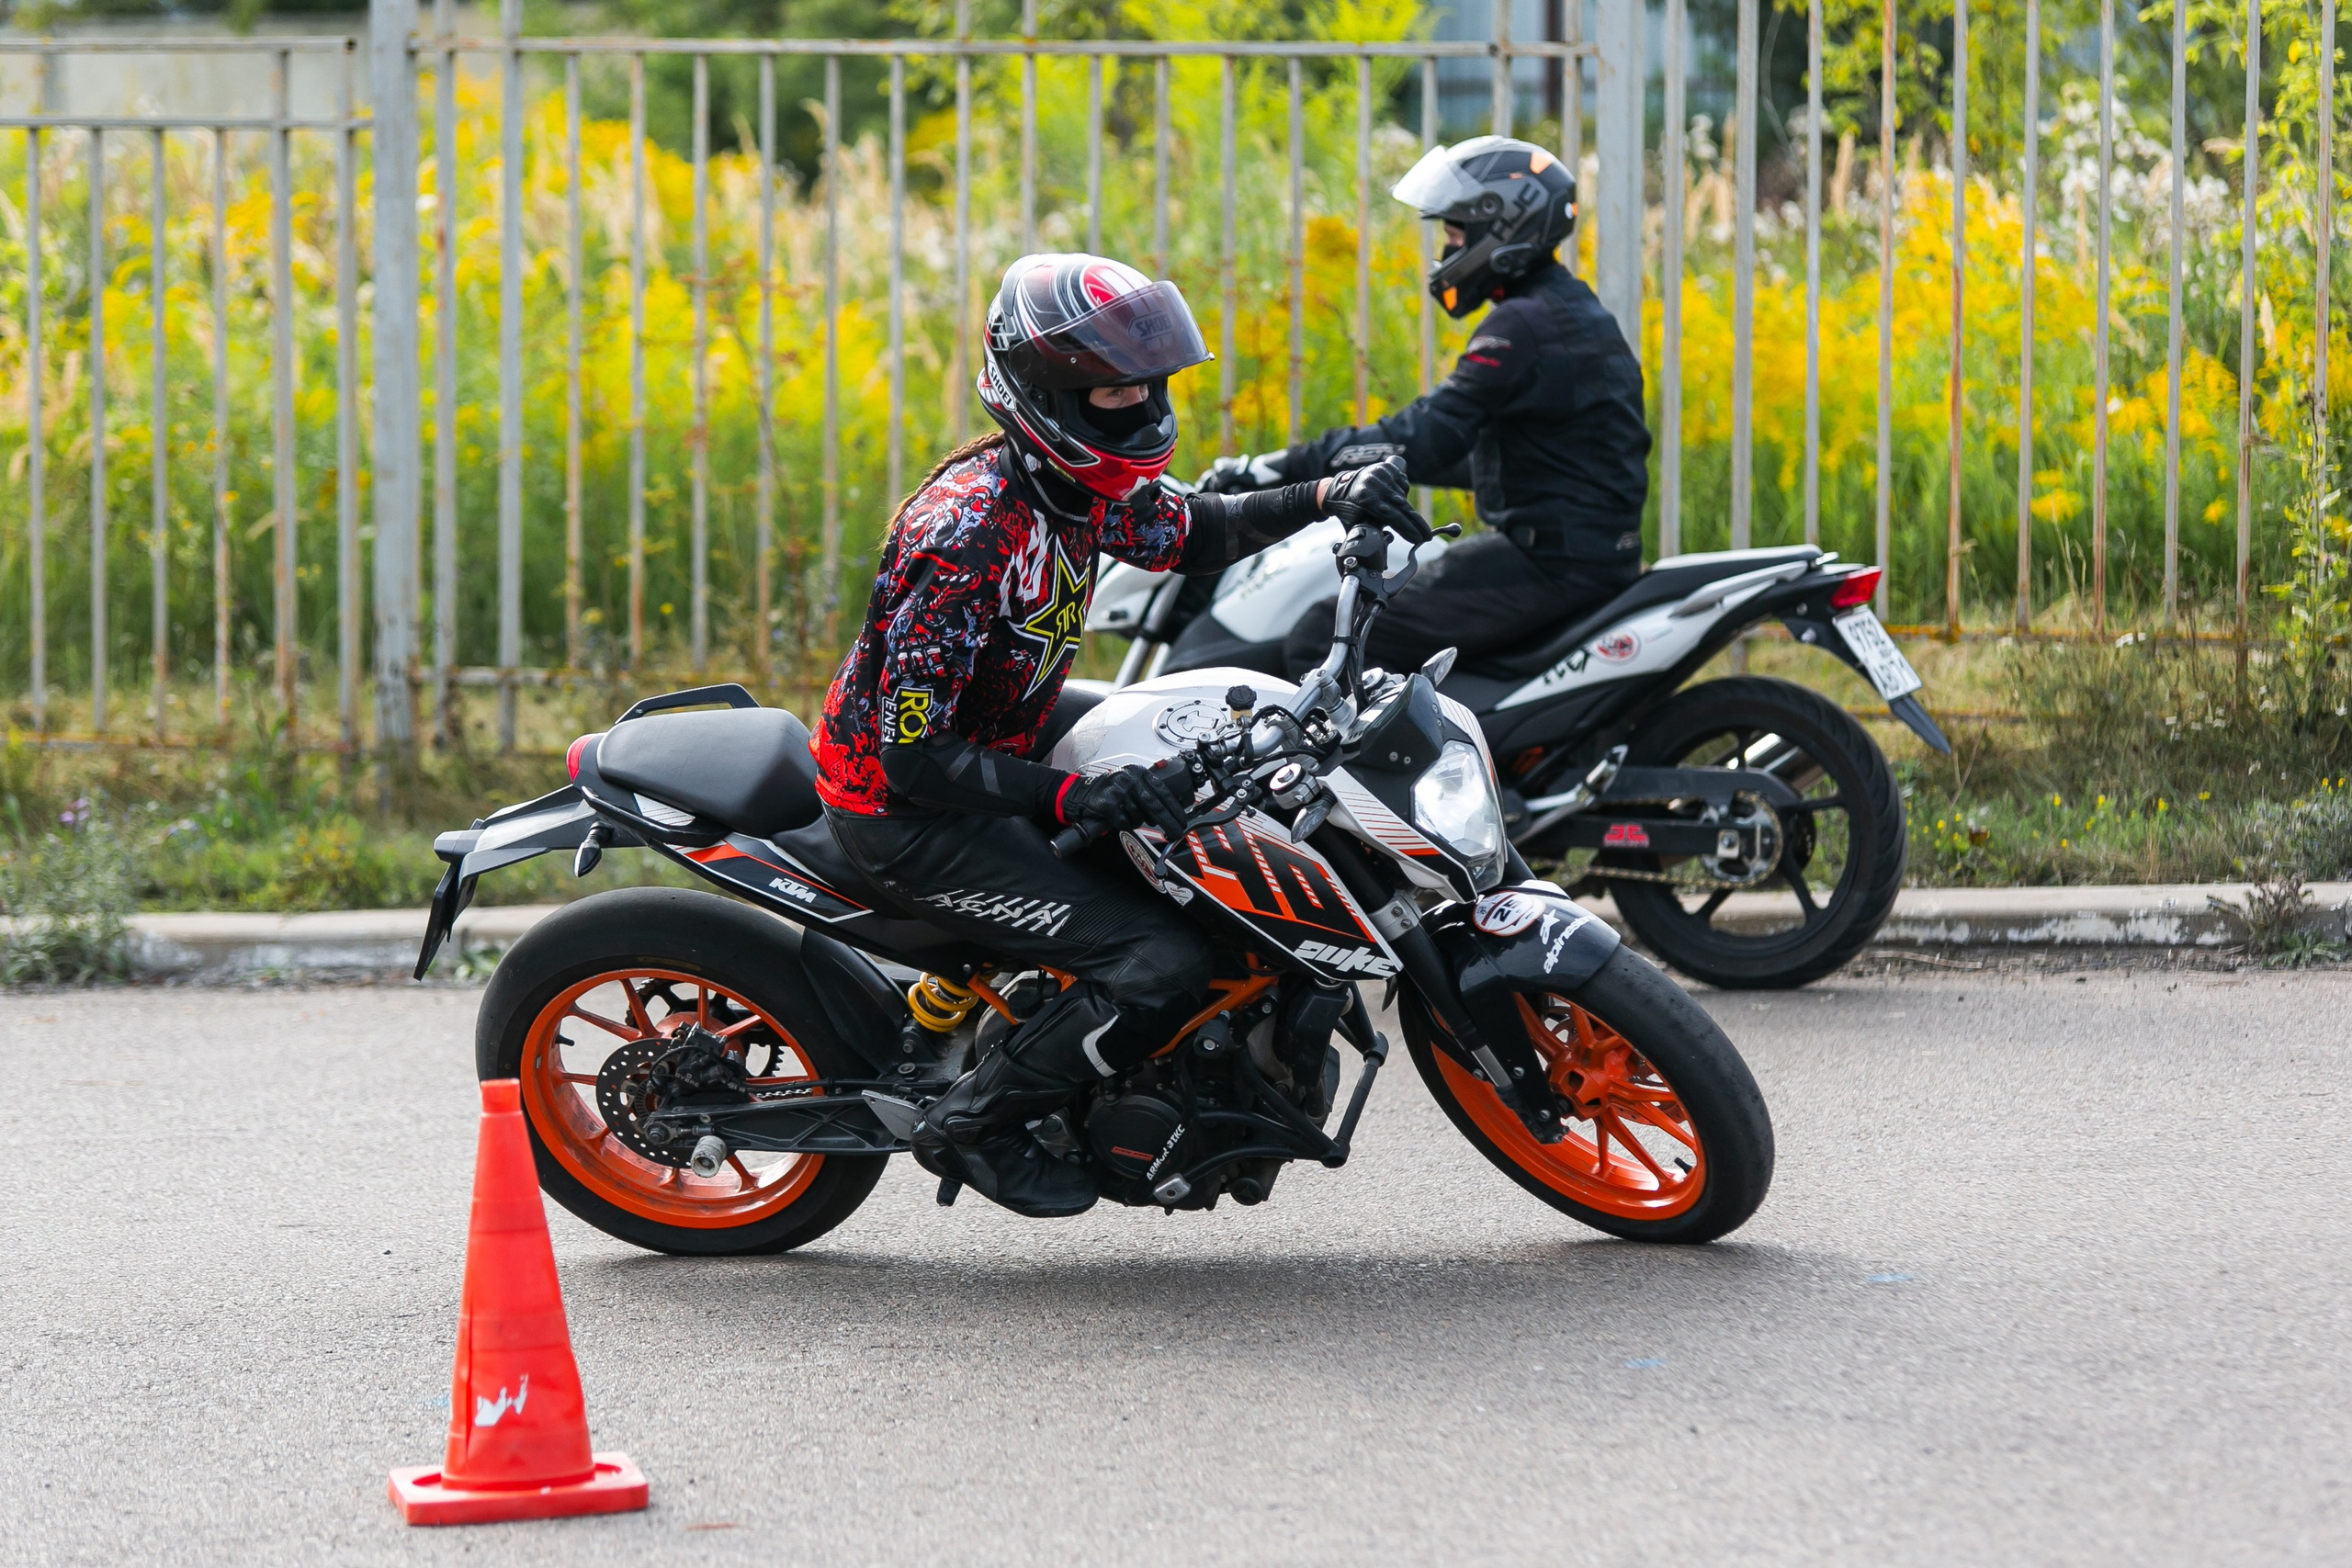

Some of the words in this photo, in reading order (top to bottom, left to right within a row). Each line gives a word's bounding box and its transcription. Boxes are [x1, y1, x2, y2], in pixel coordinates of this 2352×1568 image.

[1488, 183, 1540, 242] HJC
[989, 367, 1012, 406] SHOEI
[899, 691, 929, 743] RO
[769, 877, 817, 903] KTM
